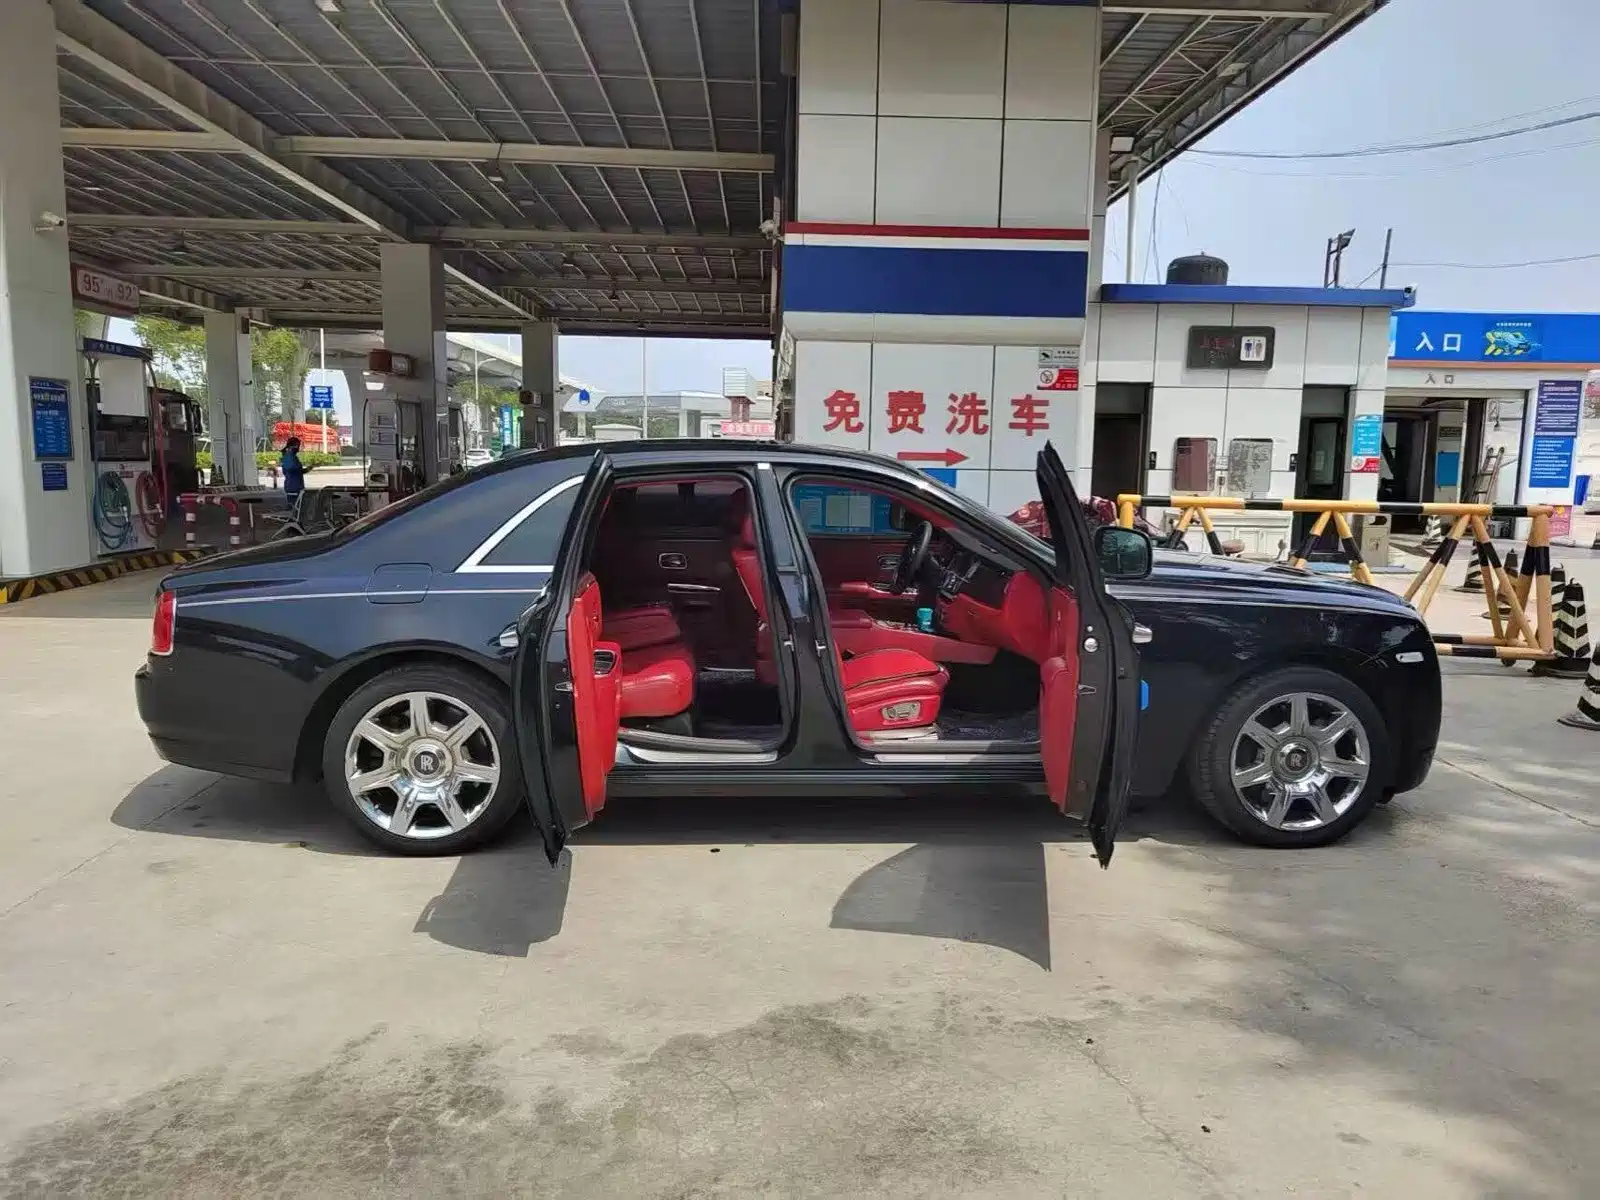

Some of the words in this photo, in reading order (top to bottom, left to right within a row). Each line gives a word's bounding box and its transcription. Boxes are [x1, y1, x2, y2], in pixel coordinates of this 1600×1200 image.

[1415, 331, 1463, 352] 入口
[1425, 372, 1454, 385] 入口
[822, 389, 1050, 436] 免费洗车
